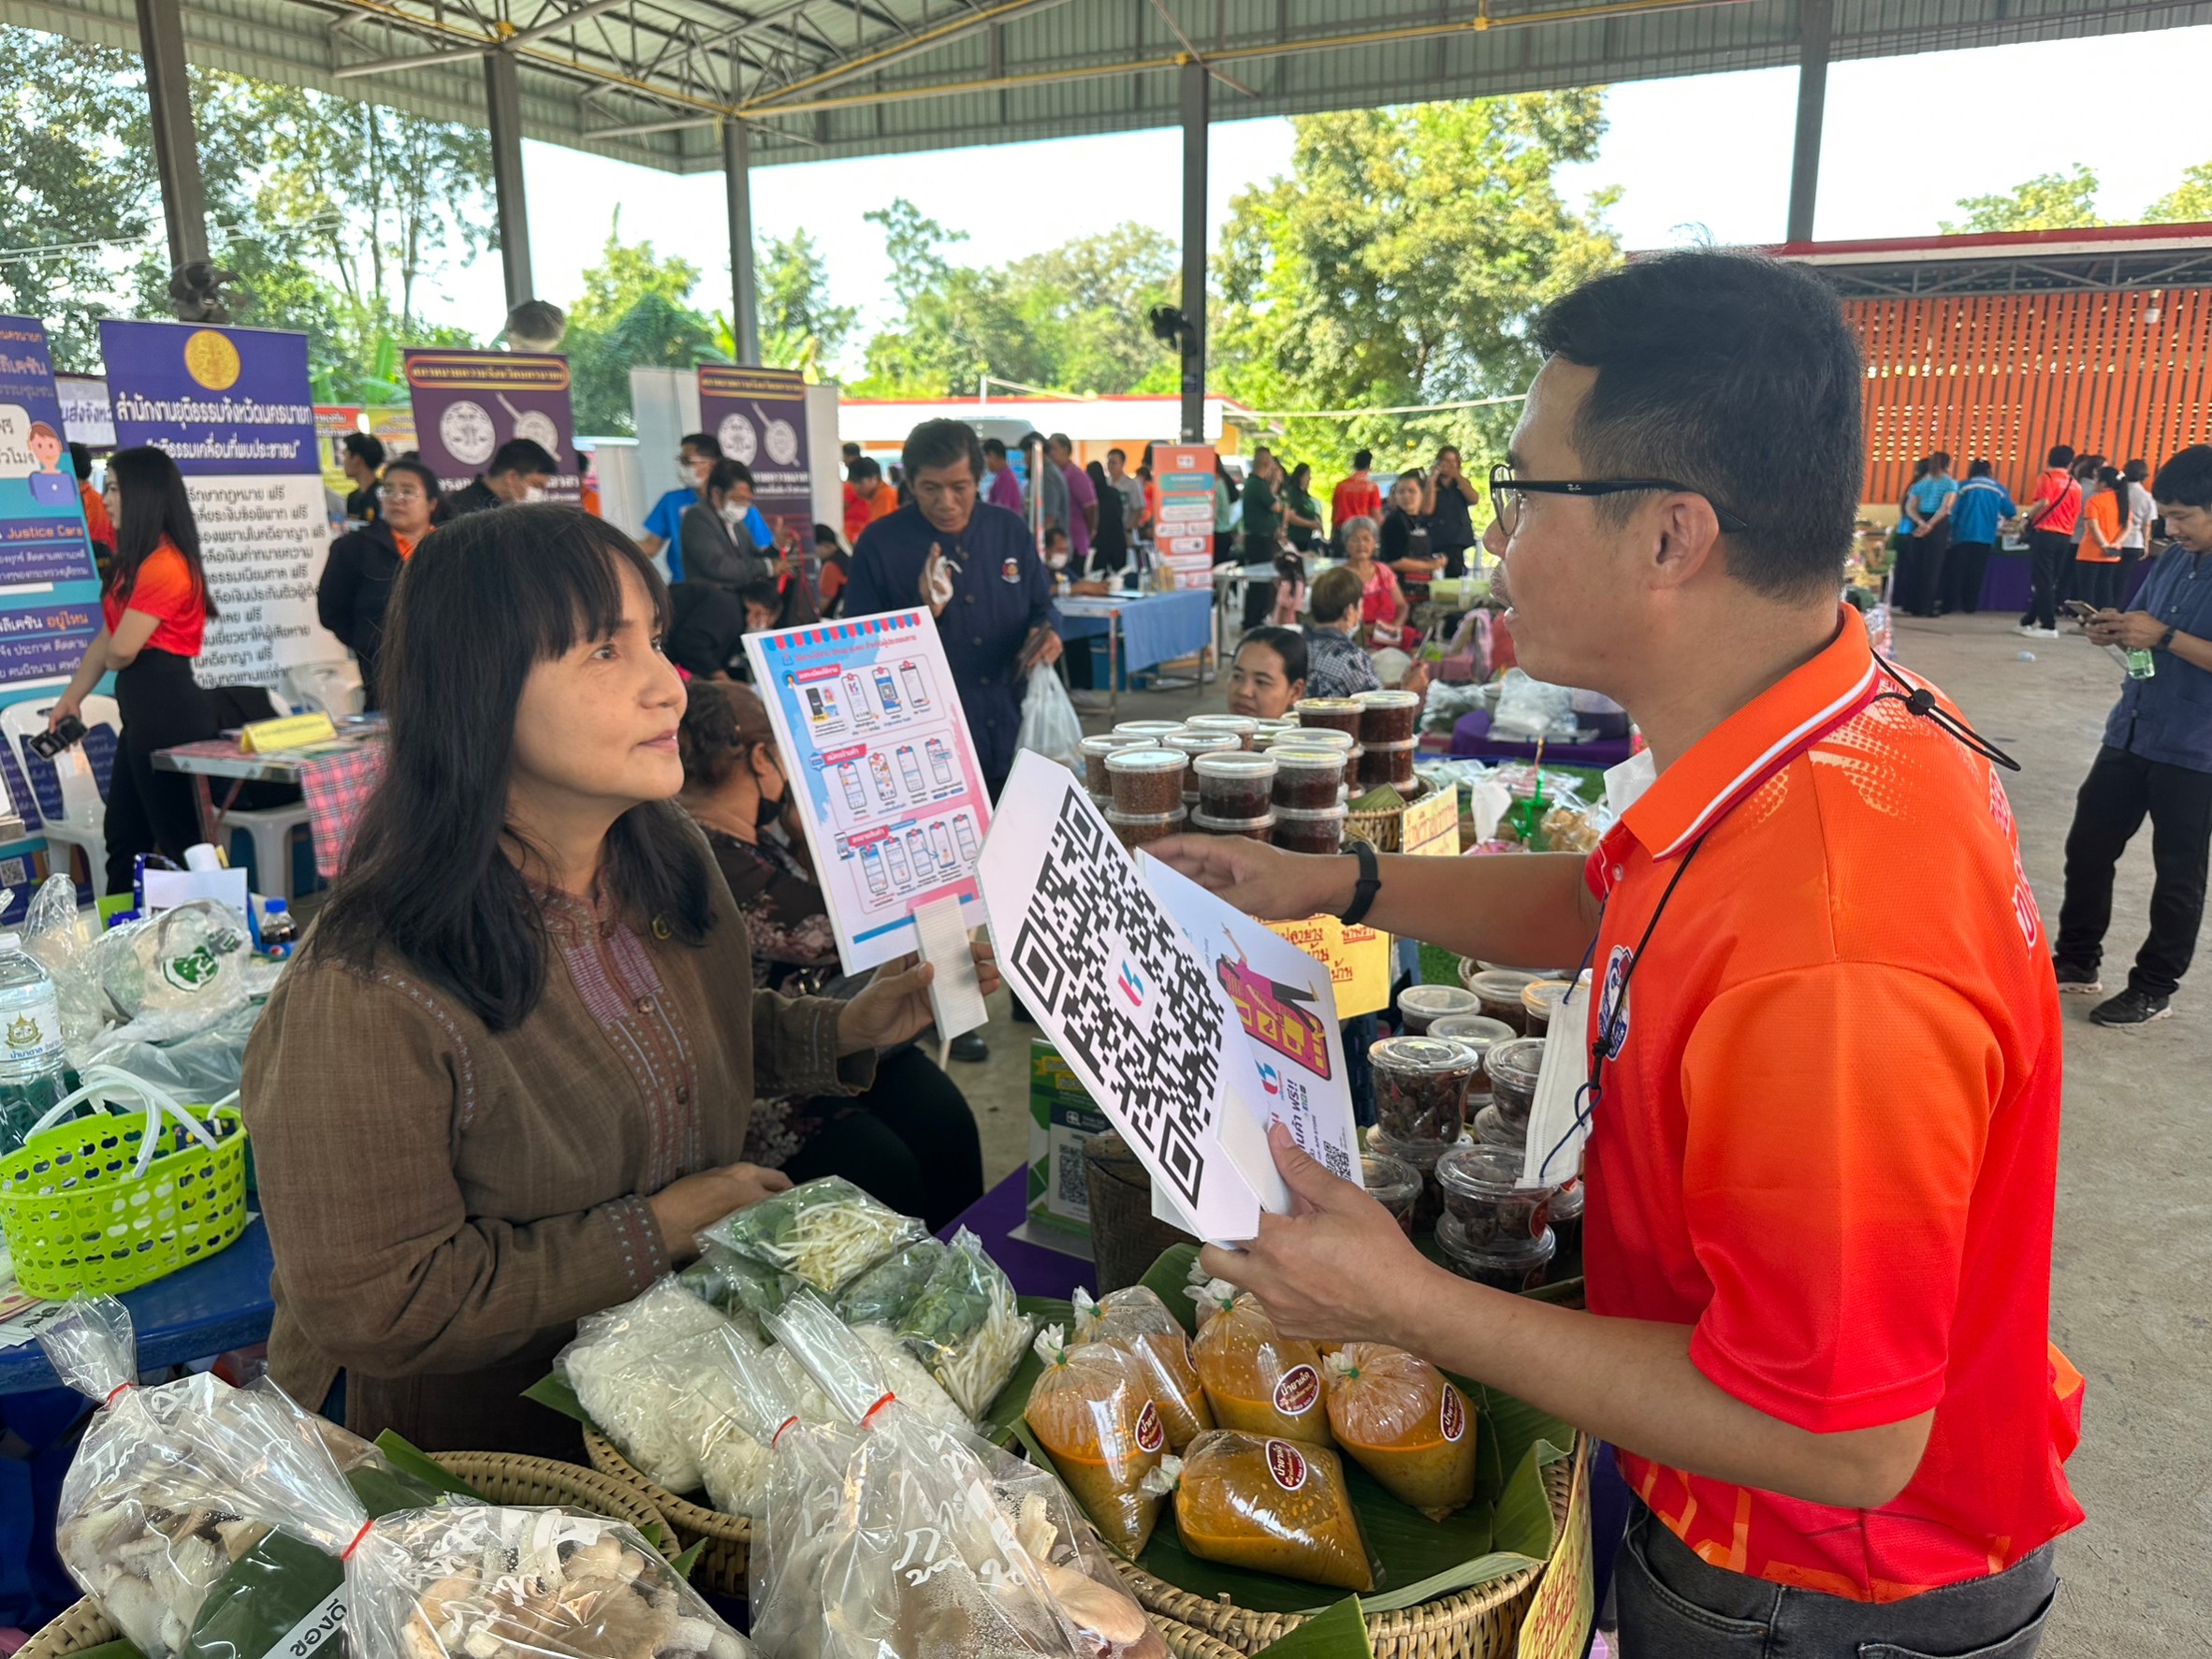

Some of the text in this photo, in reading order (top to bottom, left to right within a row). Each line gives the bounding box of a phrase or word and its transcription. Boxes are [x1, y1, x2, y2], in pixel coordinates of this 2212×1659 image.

[7, 524, 84, 540] Justice Care
[289, 1598, 347, 1657] ของดี
